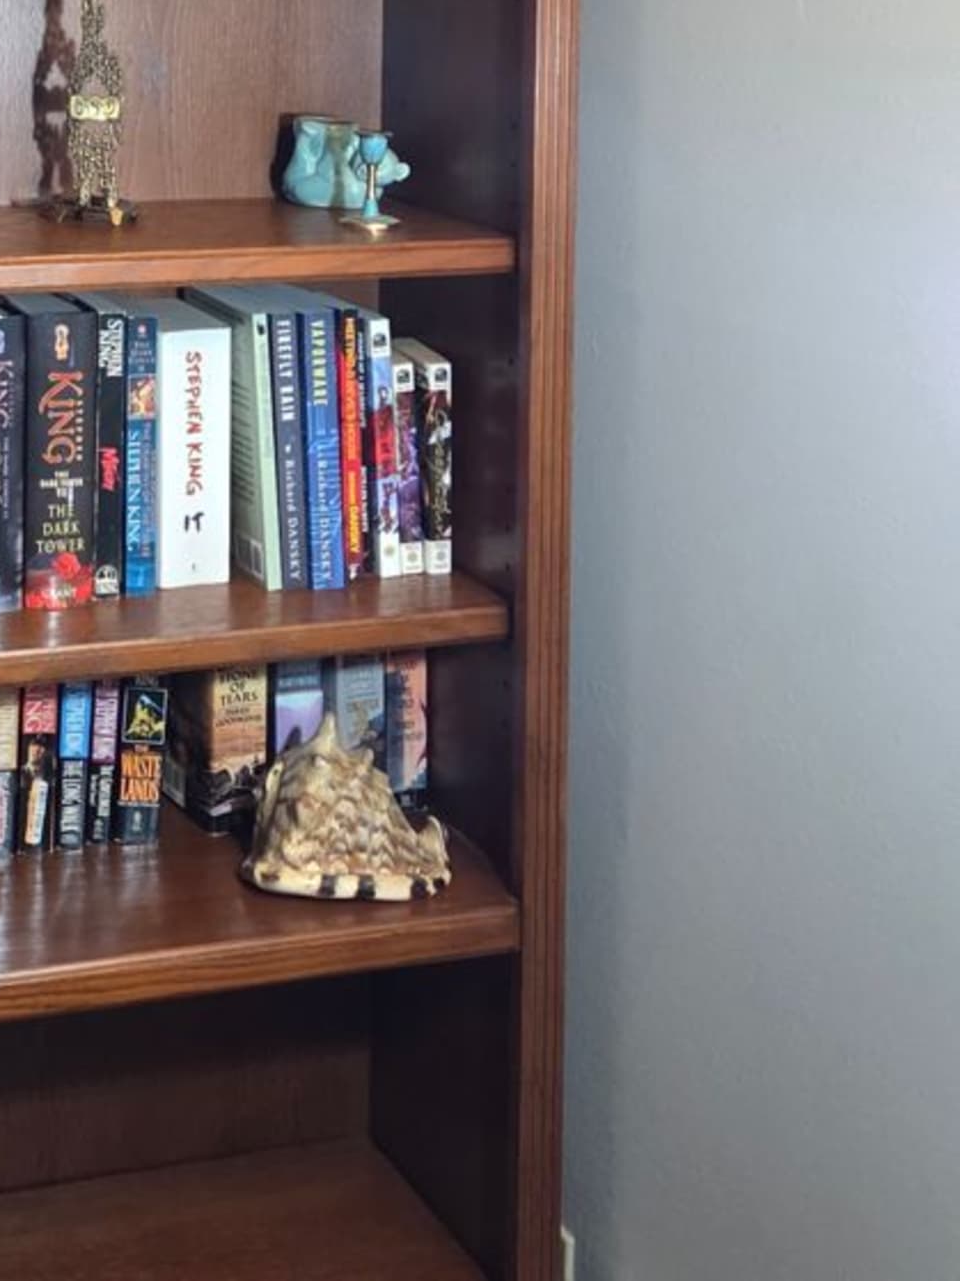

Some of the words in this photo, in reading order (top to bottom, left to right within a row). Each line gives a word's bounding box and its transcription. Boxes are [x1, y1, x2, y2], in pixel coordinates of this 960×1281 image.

[276, 320, 293, 380] FIREFLY
[185, 350, 203, 436] STEPHEN
[280, 386, 295, 422] RAIN
[39, 371, 84, 463] KING
[185, 443, 203, 496] KING
[310, 320, 328, 407] VAPORWARE
[319, 516, 333, 581] DANSKY
[285, 460, 296, 511] Richard
[42, 521, 81, 536] DARK
[48, 503, 75, 517] THE
[183, 511, 205, 533] IT
[35, 537, 85, 554] TOWER
[286, 517, 301, 580] DANSKY
[121, 751, 161, 777] WASTE
[120, 777, 159, 804] LANDS
